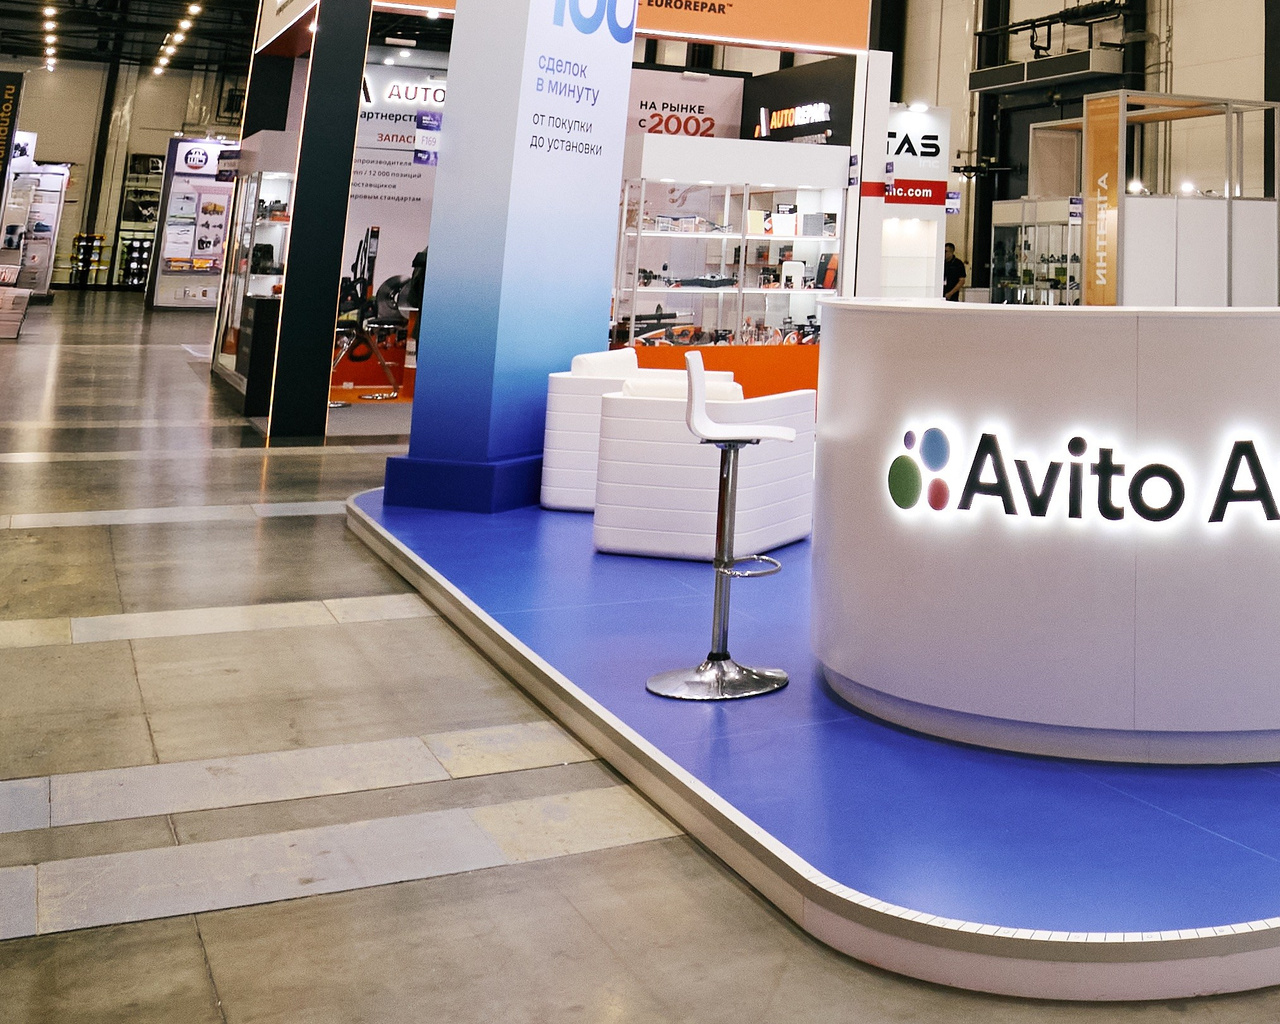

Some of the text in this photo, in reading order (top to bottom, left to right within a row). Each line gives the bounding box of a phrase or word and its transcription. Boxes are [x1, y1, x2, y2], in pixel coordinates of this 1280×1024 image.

[538, 55, 587, 79] сделок
[548, 79, 599, 107] минуту
[640, 101, 705, 115] НА РЫНКЕ
[533, 113, 592, 134] от покупки
[648, 113, 715, 137] 2002
[377, 133, 416, 144] ЗАПАС
[530, 135, 602, 156] до установки
[957, 433, 1186, 522] Avito
